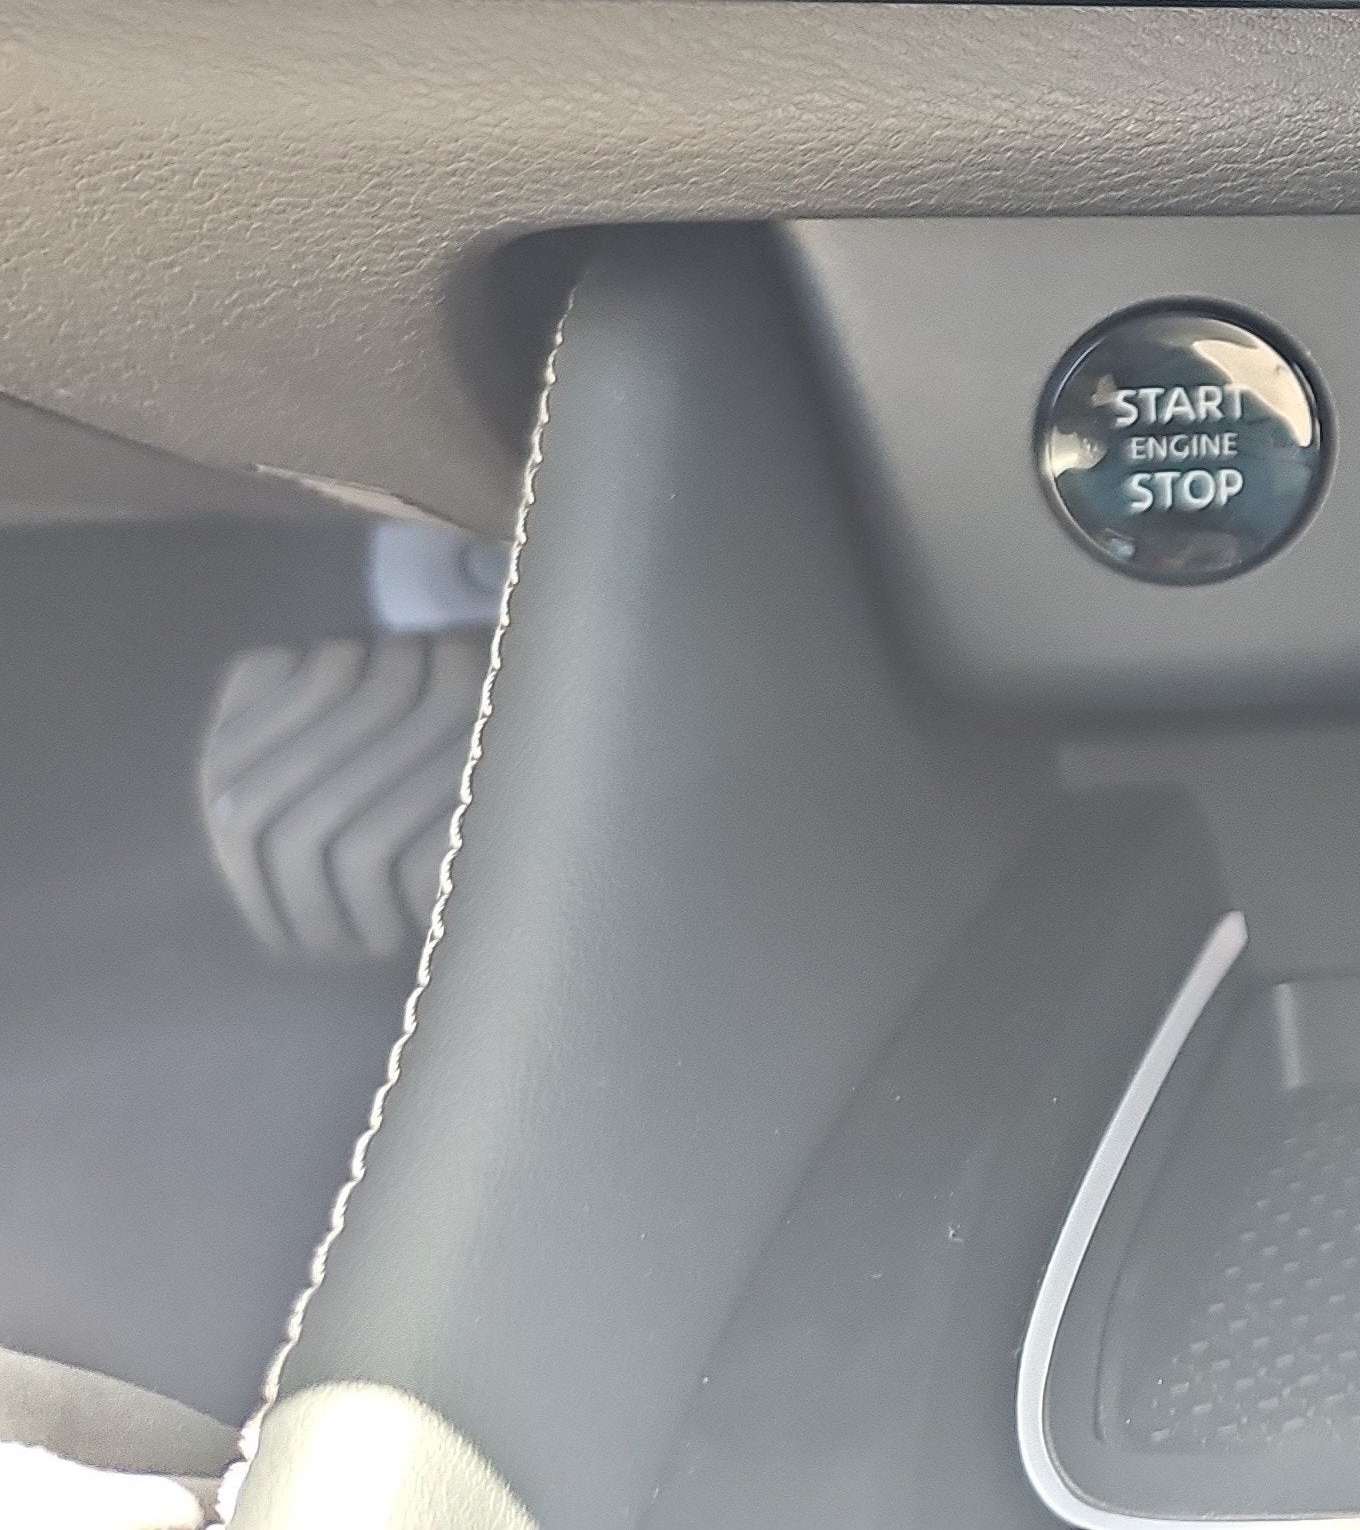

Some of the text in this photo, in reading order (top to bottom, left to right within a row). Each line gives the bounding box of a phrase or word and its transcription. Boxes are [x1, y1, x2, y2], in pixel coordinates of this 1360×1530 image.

[1113, 384, 1247, 427] START
[1129, 432, 1239, 461] ENGINE
[1127, 468, 1244, 513] STOP
